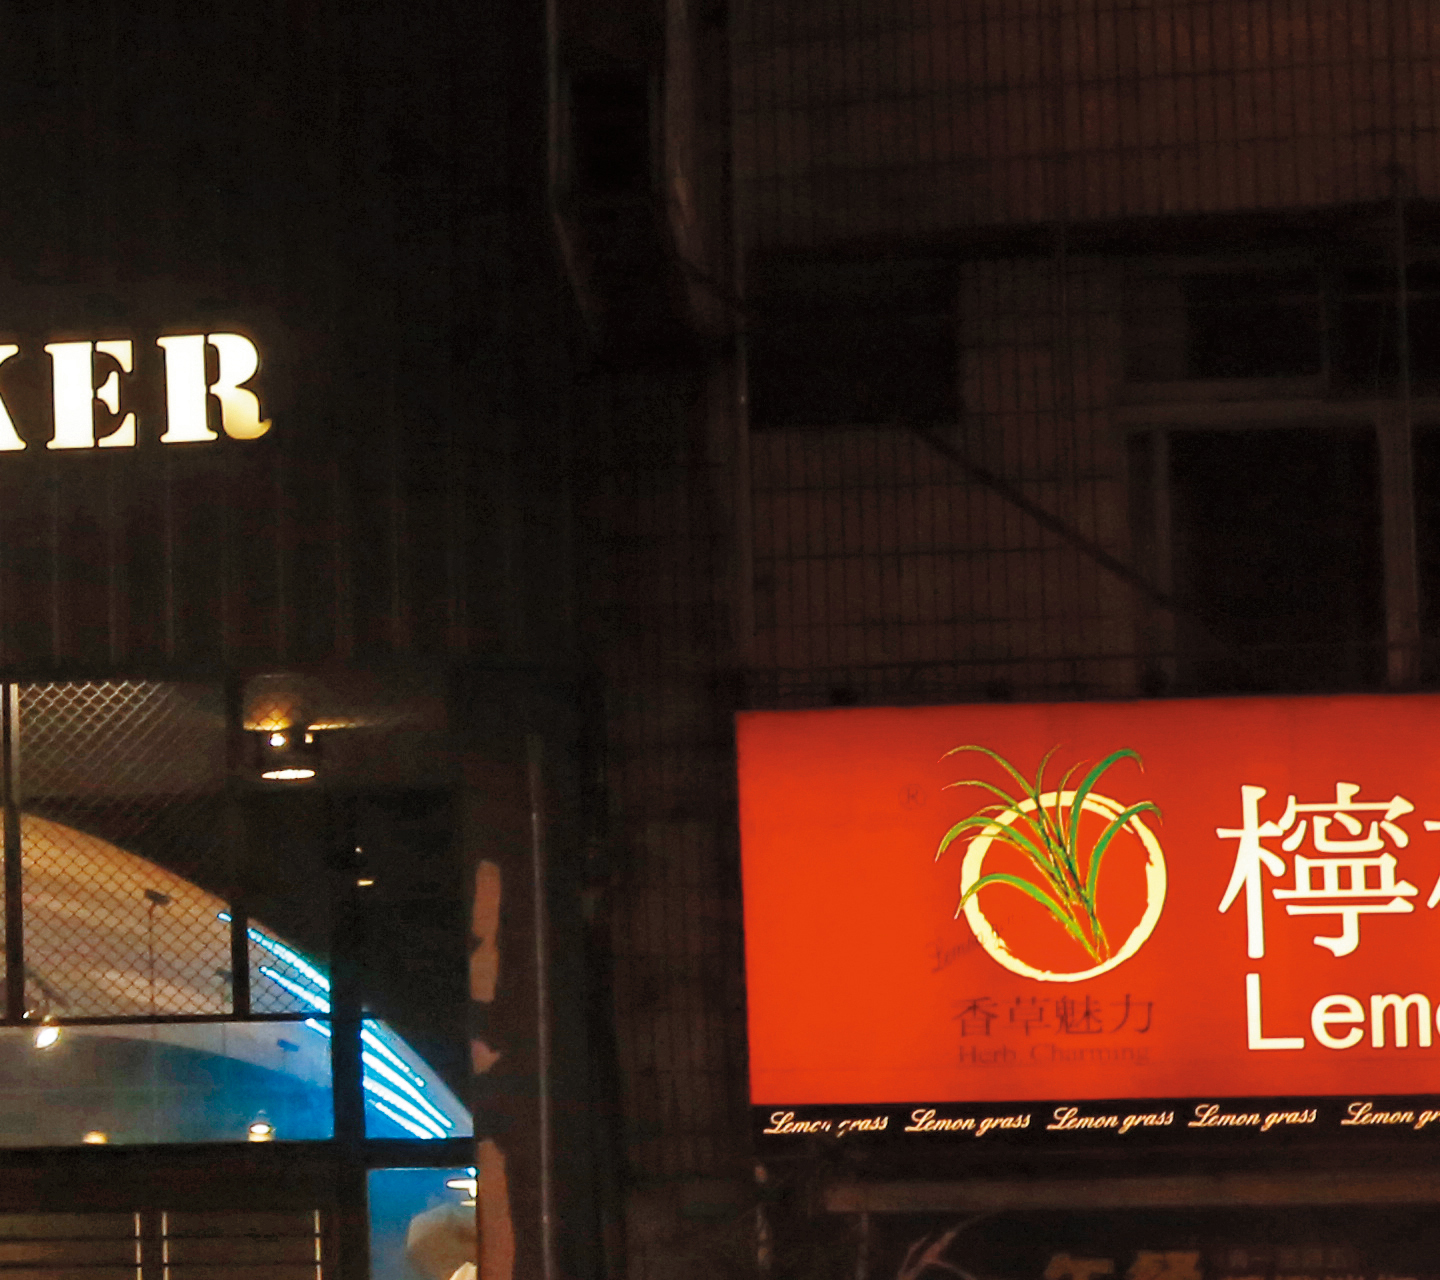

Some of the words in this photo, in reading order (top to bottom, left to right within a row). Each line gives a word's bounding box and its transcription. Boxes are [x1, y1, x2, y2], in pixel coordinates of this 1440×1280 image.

[1216, 782, 1440, 959] 檸
[952, 994, 1154, 1038] 香草魅力
[1246, 973, 1440, 1050] Lem
[904, 1109, 975, 1132] Lemon
[974, 1114, 1031, 1137] grass
[1046, 1107, 1118, 1130] Lemon
[1117, 1111, 1174, 1134] grass
[1188, 1104, 1260, 1127] Lemon
[1259, 1109, 1318, 1132] grass
[1340, 1102, 1415, 1126] Lemon
